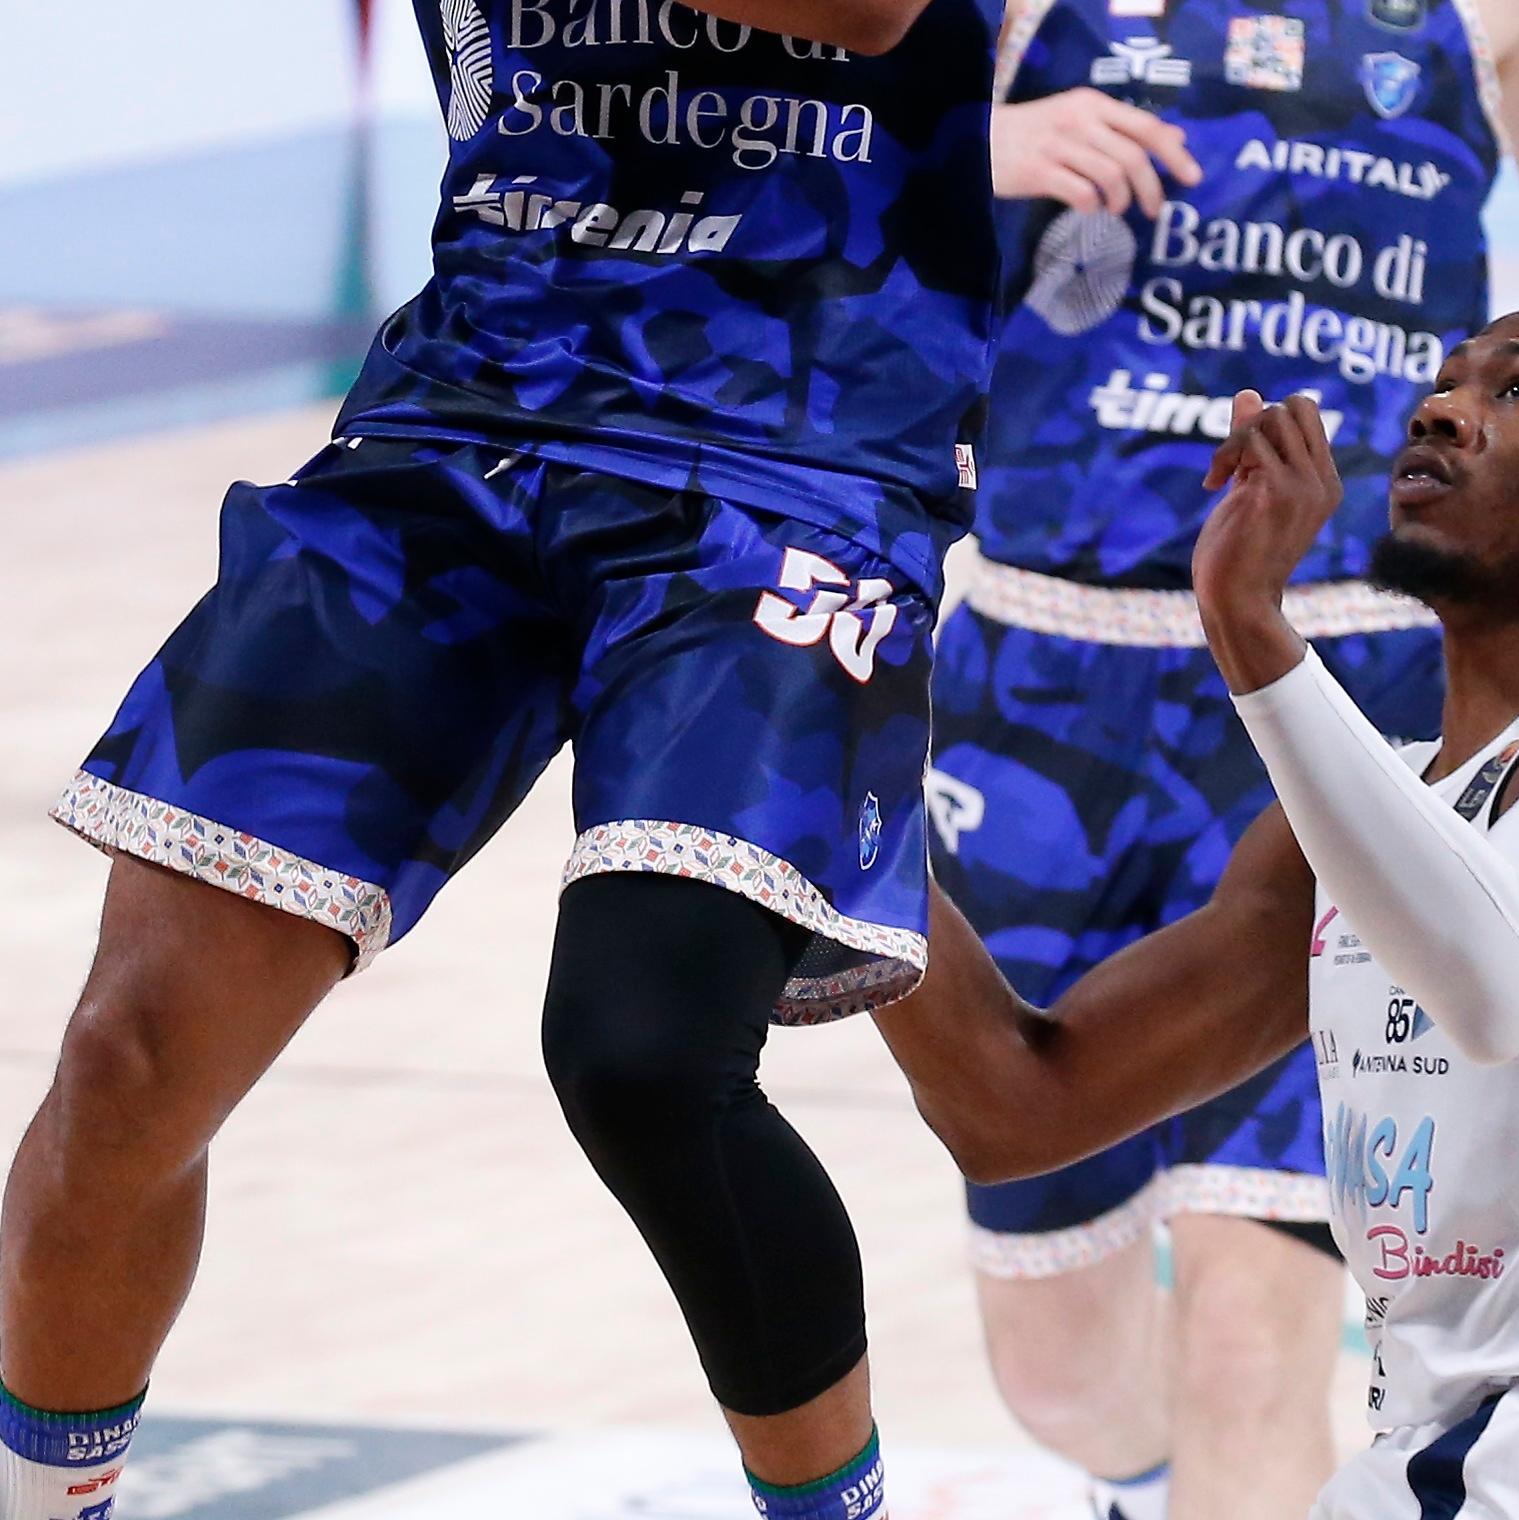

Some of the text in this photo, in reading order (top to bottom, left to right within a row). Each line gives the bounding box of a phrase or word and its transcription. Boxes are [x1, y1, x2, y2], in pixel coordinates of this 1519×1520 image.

[496, 70, 875, 171] Sardegna
[1234, 138, 1452, 201] AIRITALY
[1150, 199, 1429, 306] Banco di
[1136, 276, 1444, 384] Sardegna
[1385, 998, 1414, 1044] 85
[1413, 1056, 1449, 1075] SUD
